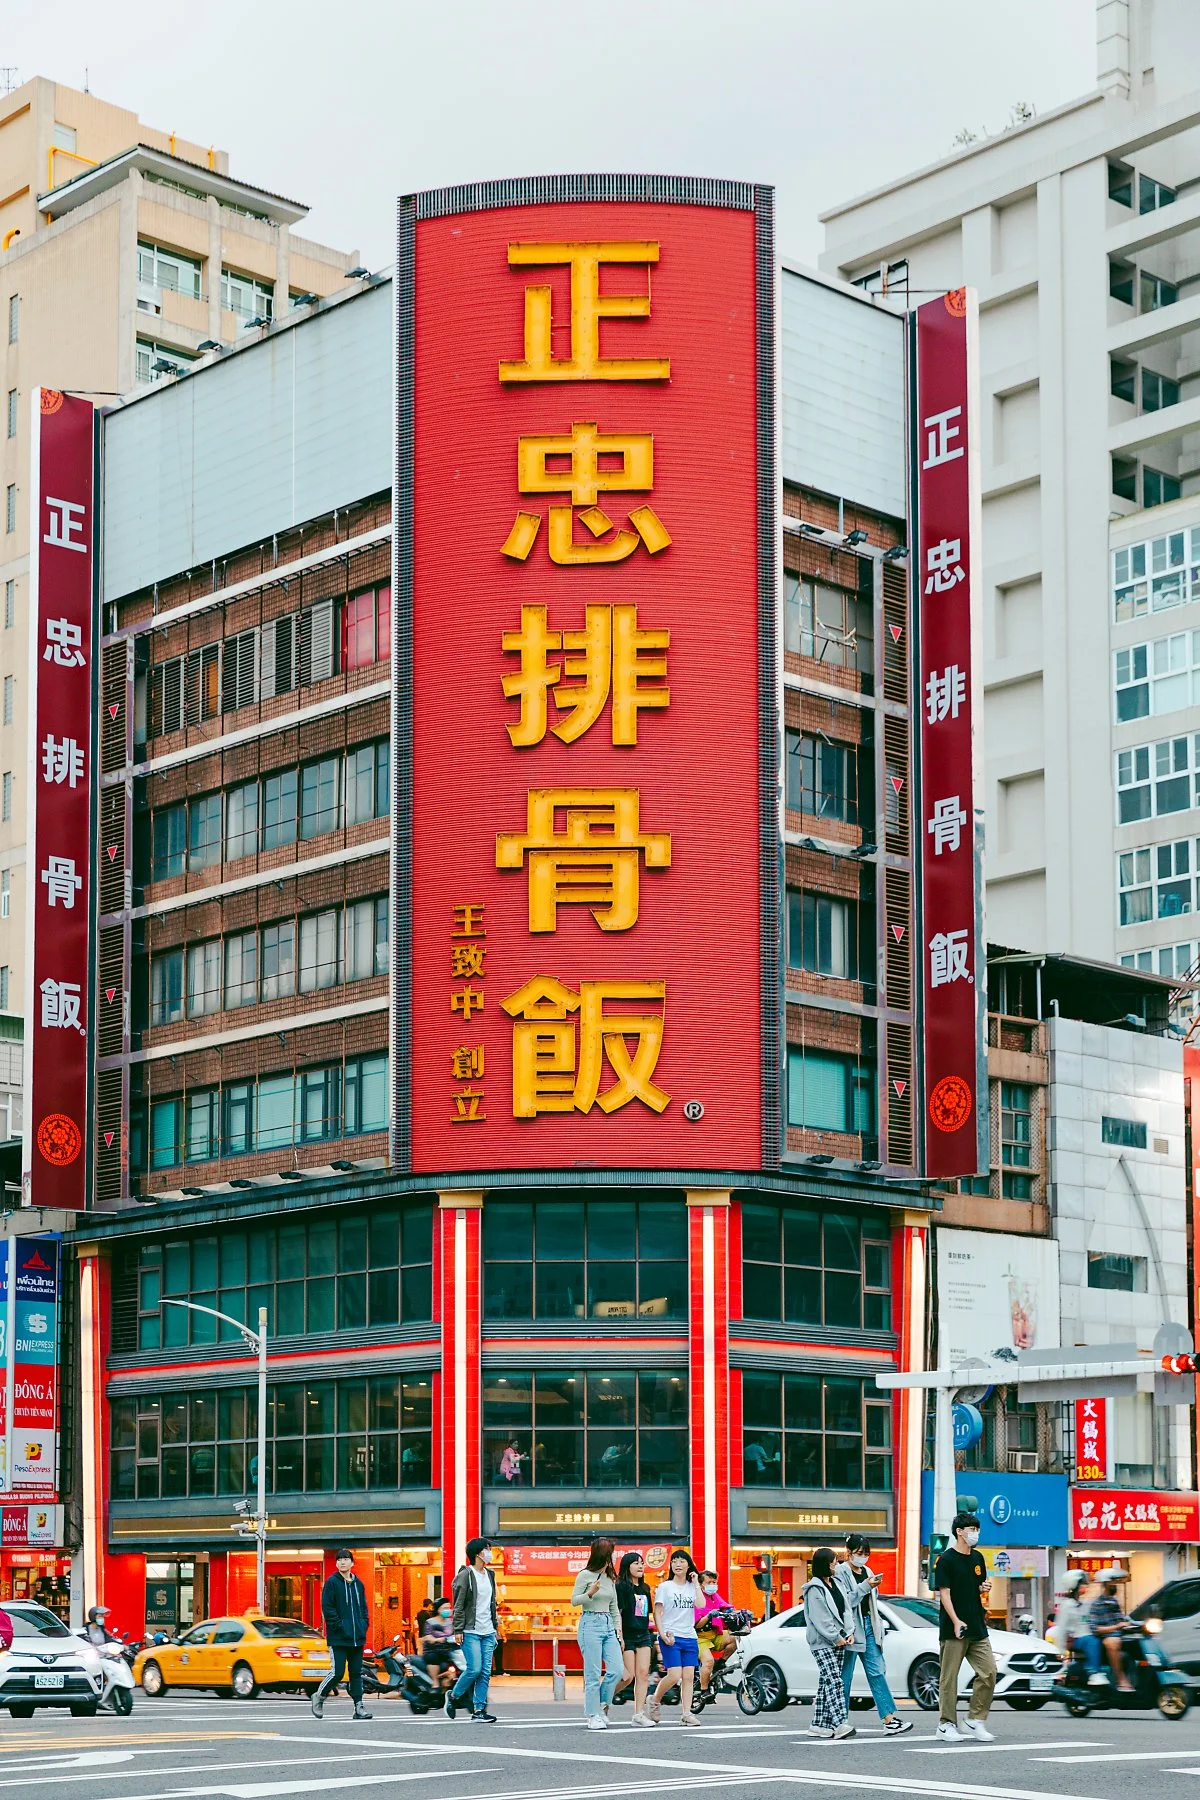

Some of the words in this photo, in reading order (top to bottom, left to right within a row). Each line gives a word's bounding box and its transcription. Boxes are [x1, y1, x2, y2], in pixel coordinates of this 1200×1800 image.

[496, 241, 673, 1118] 正忠排骨飯
[923, 405, 970, 989] 正忠排骨飯
[39, 495, 88, 1030] 正忠排骨飯
[450, 1043, 487, 1123] 創立
[15, 1379, 45, 1400] ĐÔNG
[46, 1381, 53, 1400] Á
[555, 1513, 600, 1522] 正忠排骨飯
[1013, 1508, 1039, 1517] teabar
